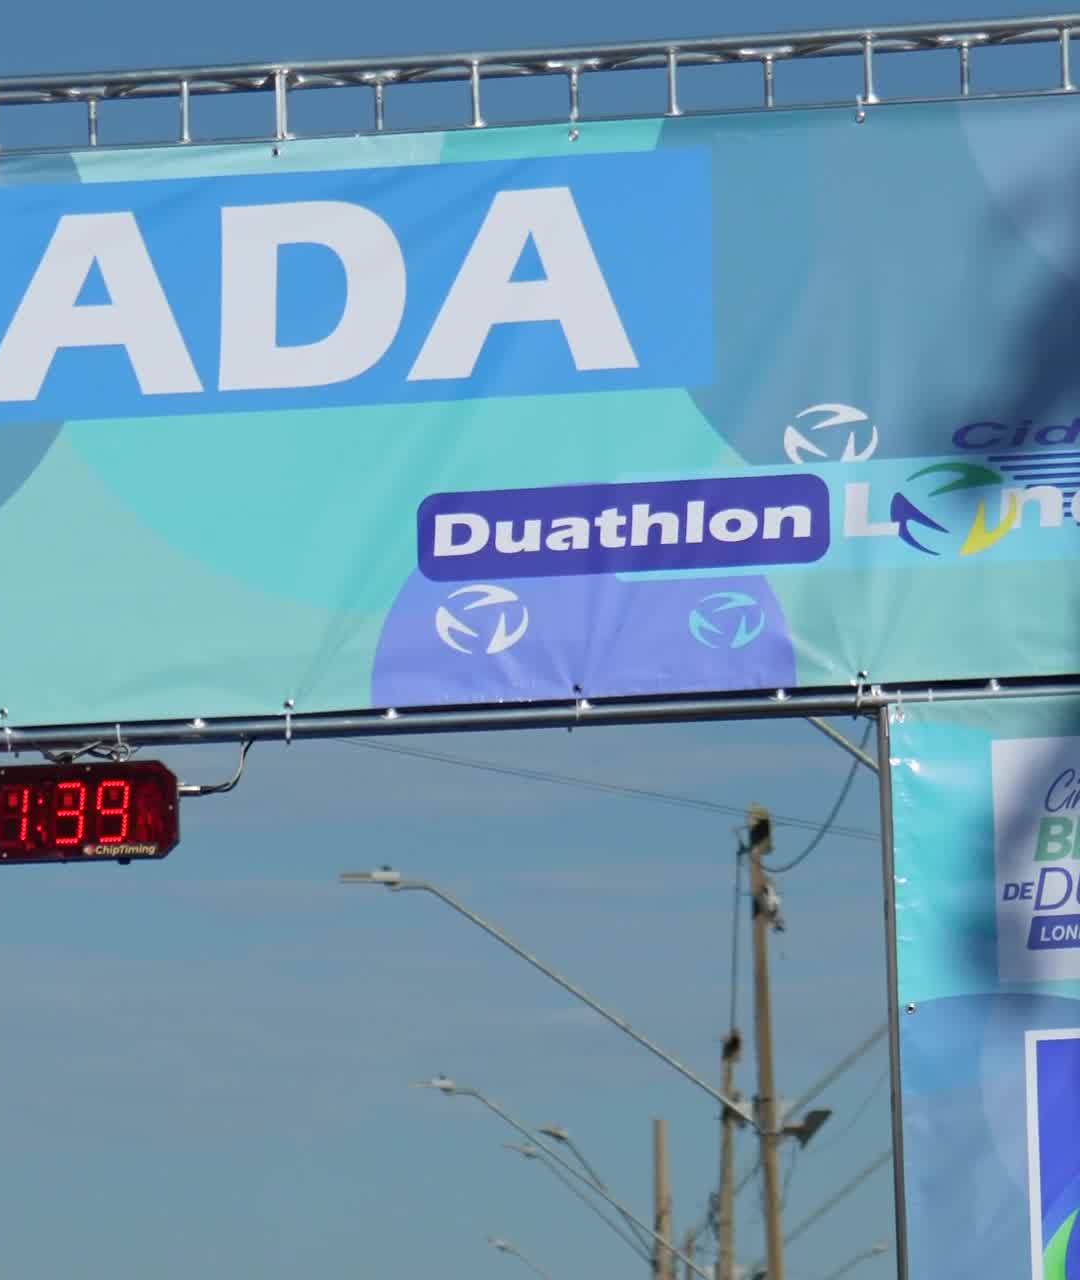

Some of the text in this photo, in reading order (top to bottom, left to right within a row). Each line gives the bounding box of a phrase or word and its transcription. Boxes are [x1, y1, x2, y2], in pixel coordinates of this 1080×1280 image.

[432, 500, 812, 557] Duathlon
[95, 844, 156, 857] ChipTiming
[1003, 882, 1035, 901] DE
